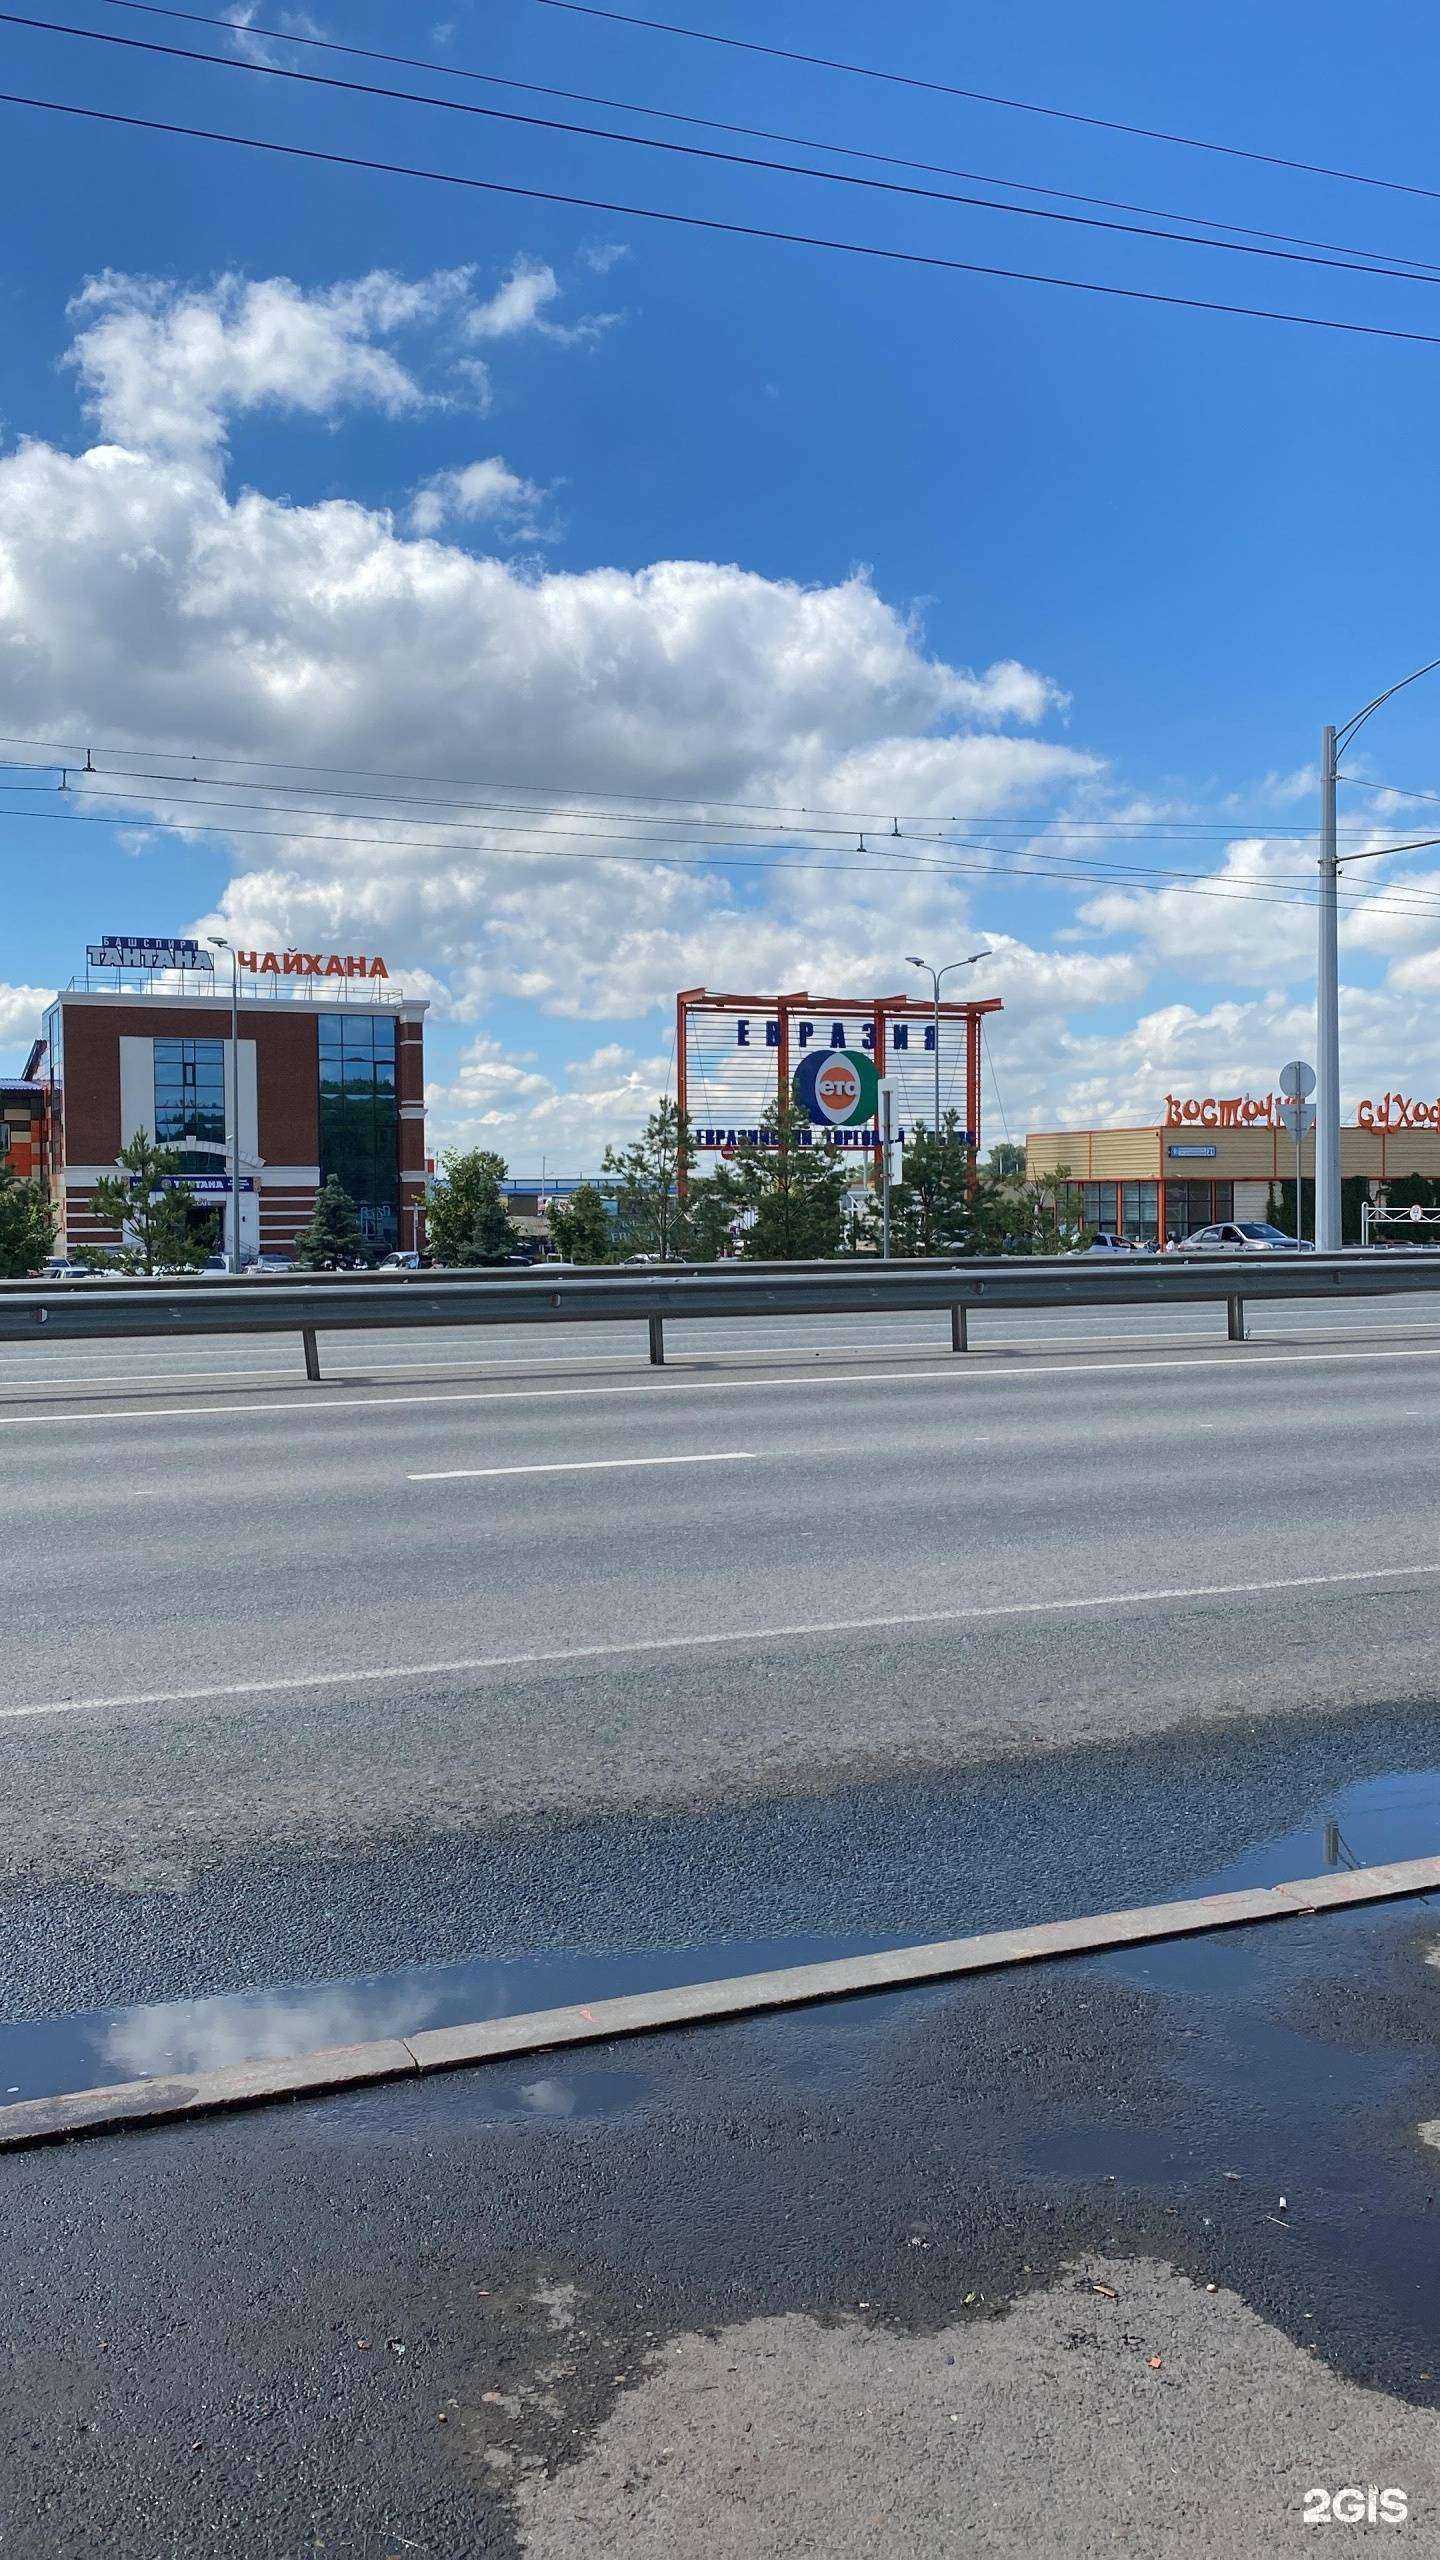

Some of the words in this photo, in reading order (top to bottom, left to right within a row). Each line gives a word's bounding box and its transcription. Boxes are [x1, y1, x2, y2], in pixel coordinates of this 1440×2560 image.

[103, 937, 198, 950] БАШСПИРТ
[87, 946, 214, 970] ТАНТАНА
[238, 948, 389, 978] ЧАЙХАНА
[737, 1019, 936, 1051] ЕВРАЗИЯ
